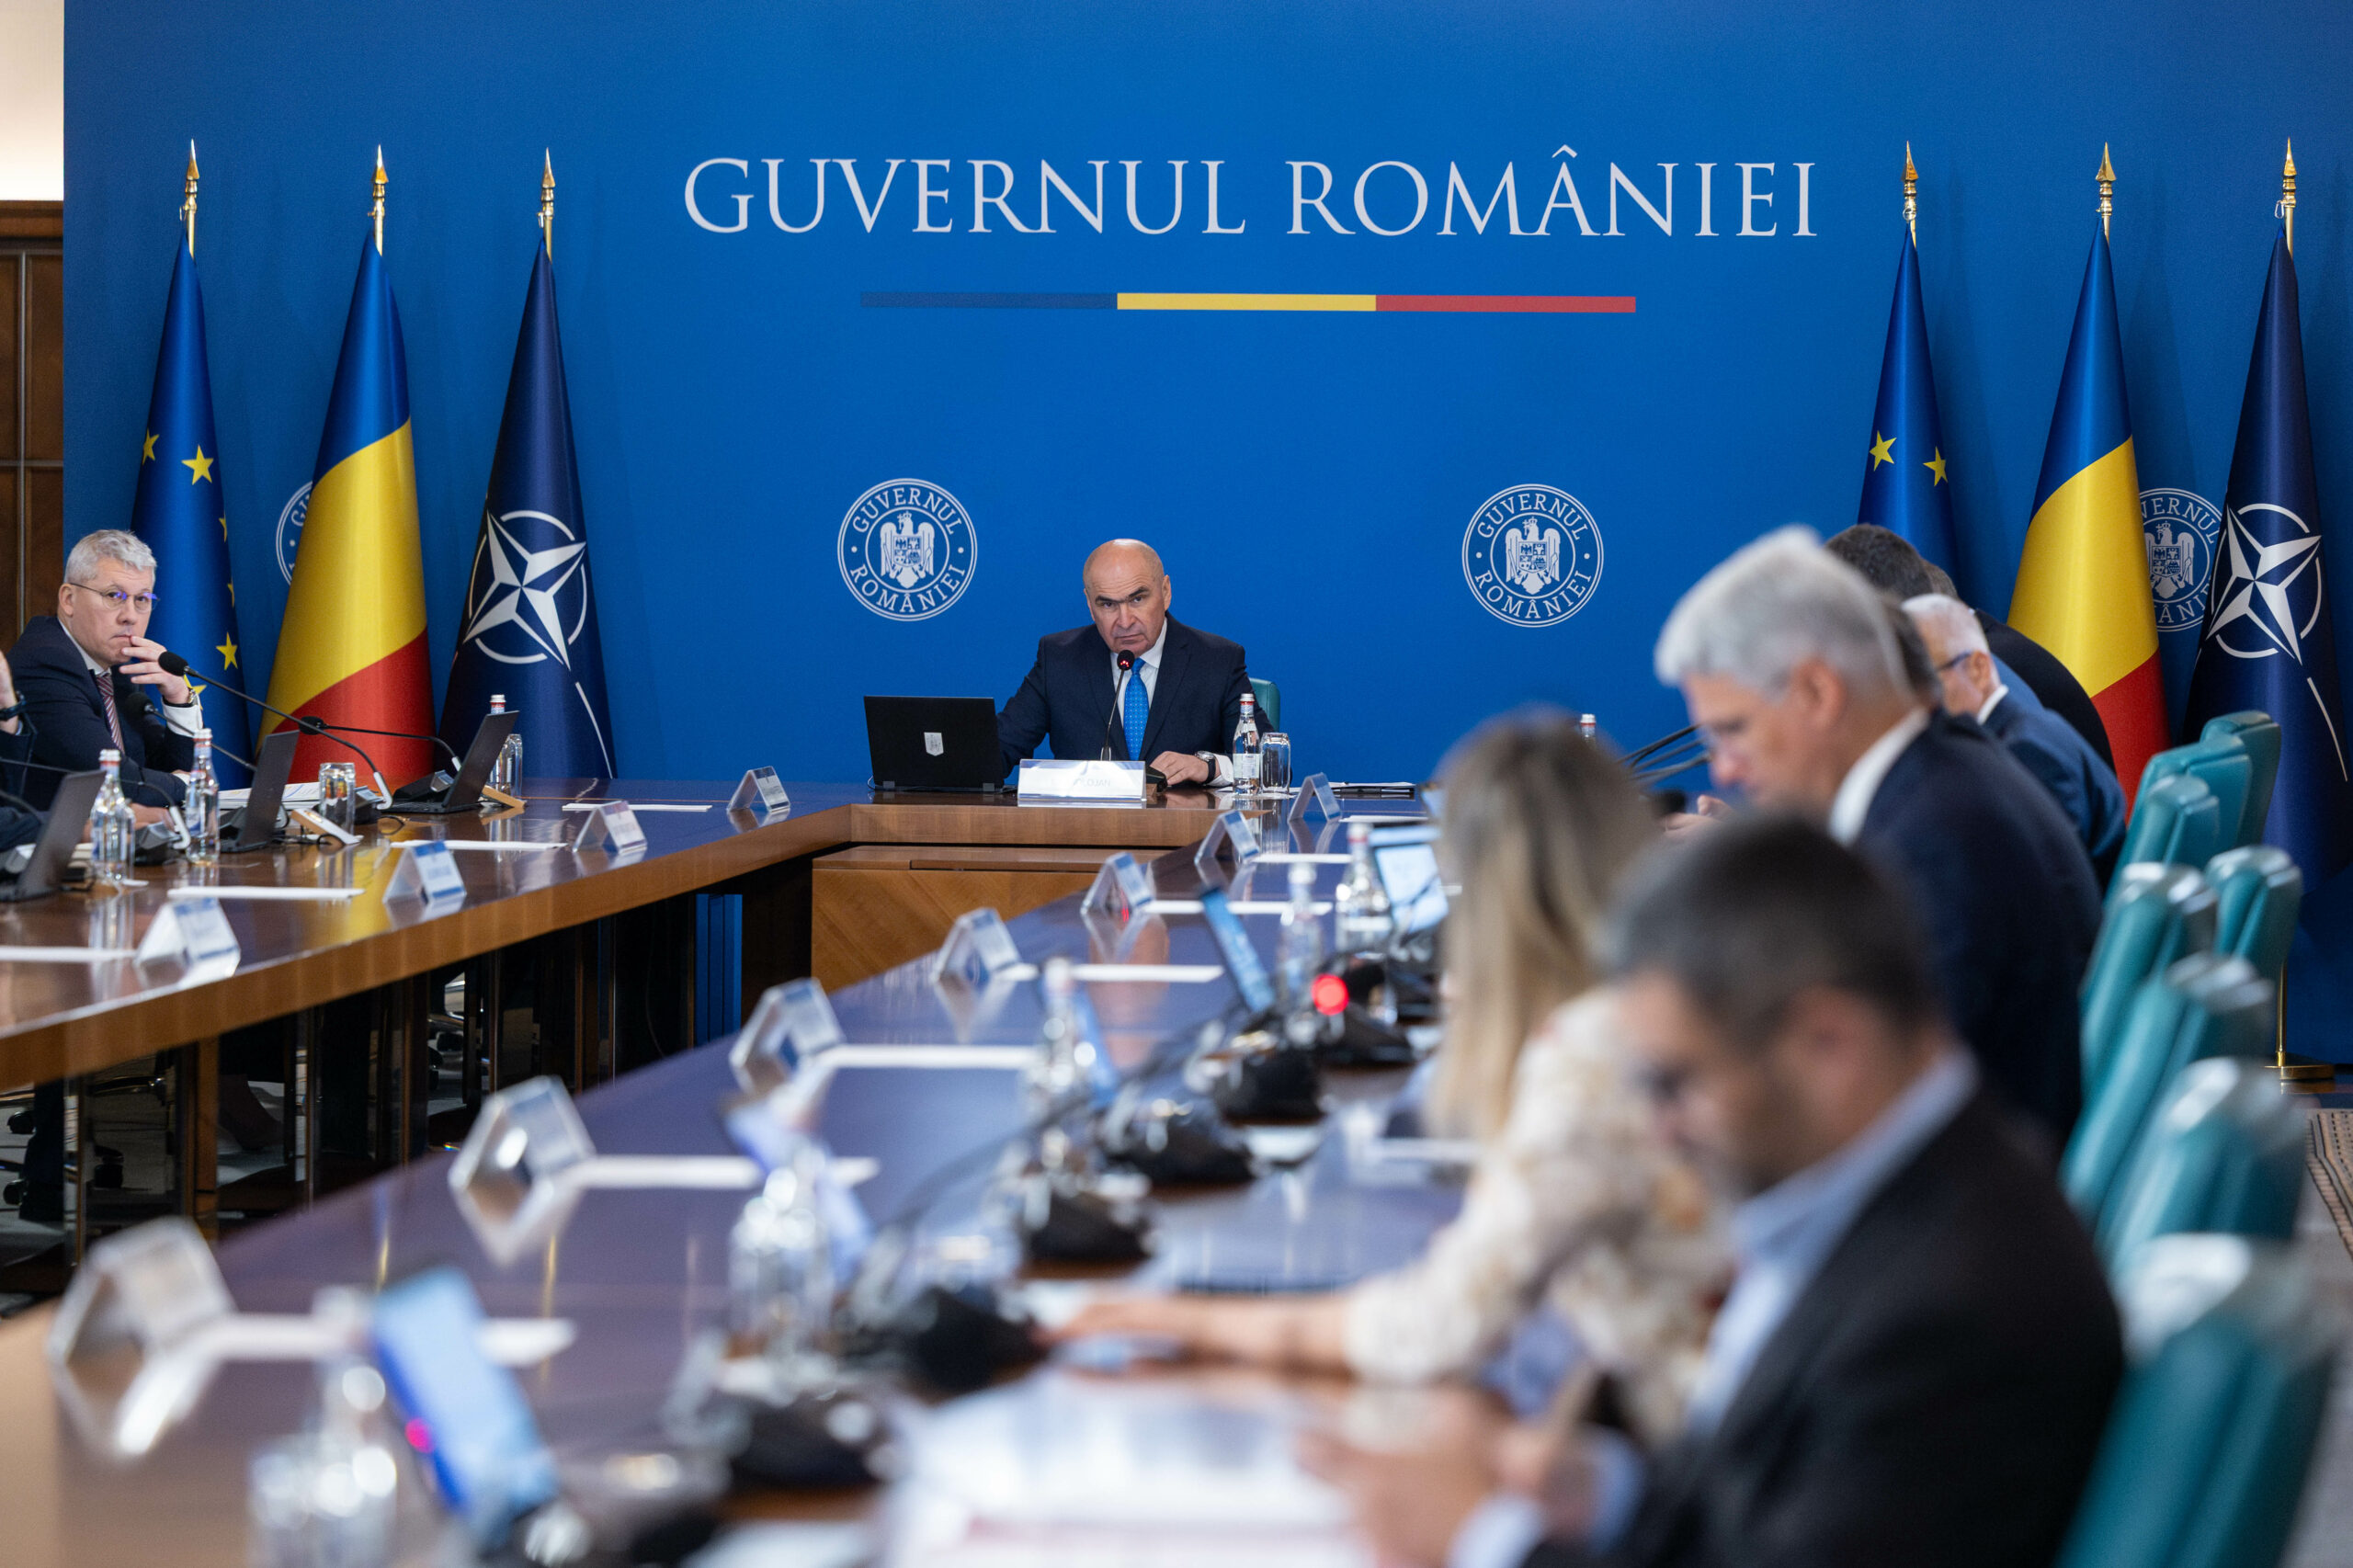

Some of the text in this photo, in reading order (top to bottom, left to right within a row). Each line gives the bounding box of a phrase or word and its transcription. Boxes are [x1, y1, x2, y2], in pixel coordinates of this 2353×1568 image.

[684, 144, 1817, 236] GUVERNUL ROMÂNIEI
[852, 487, 962, 535] GUVERNUL
[1477, 493, 1588, 540] GUVERNUL
[2140, 497, 2220, 544] VERNUL
[849, 564, 965, 613] ROMÂNIEI
[1474, 570, 1592, 619] ROMÂNIEI
